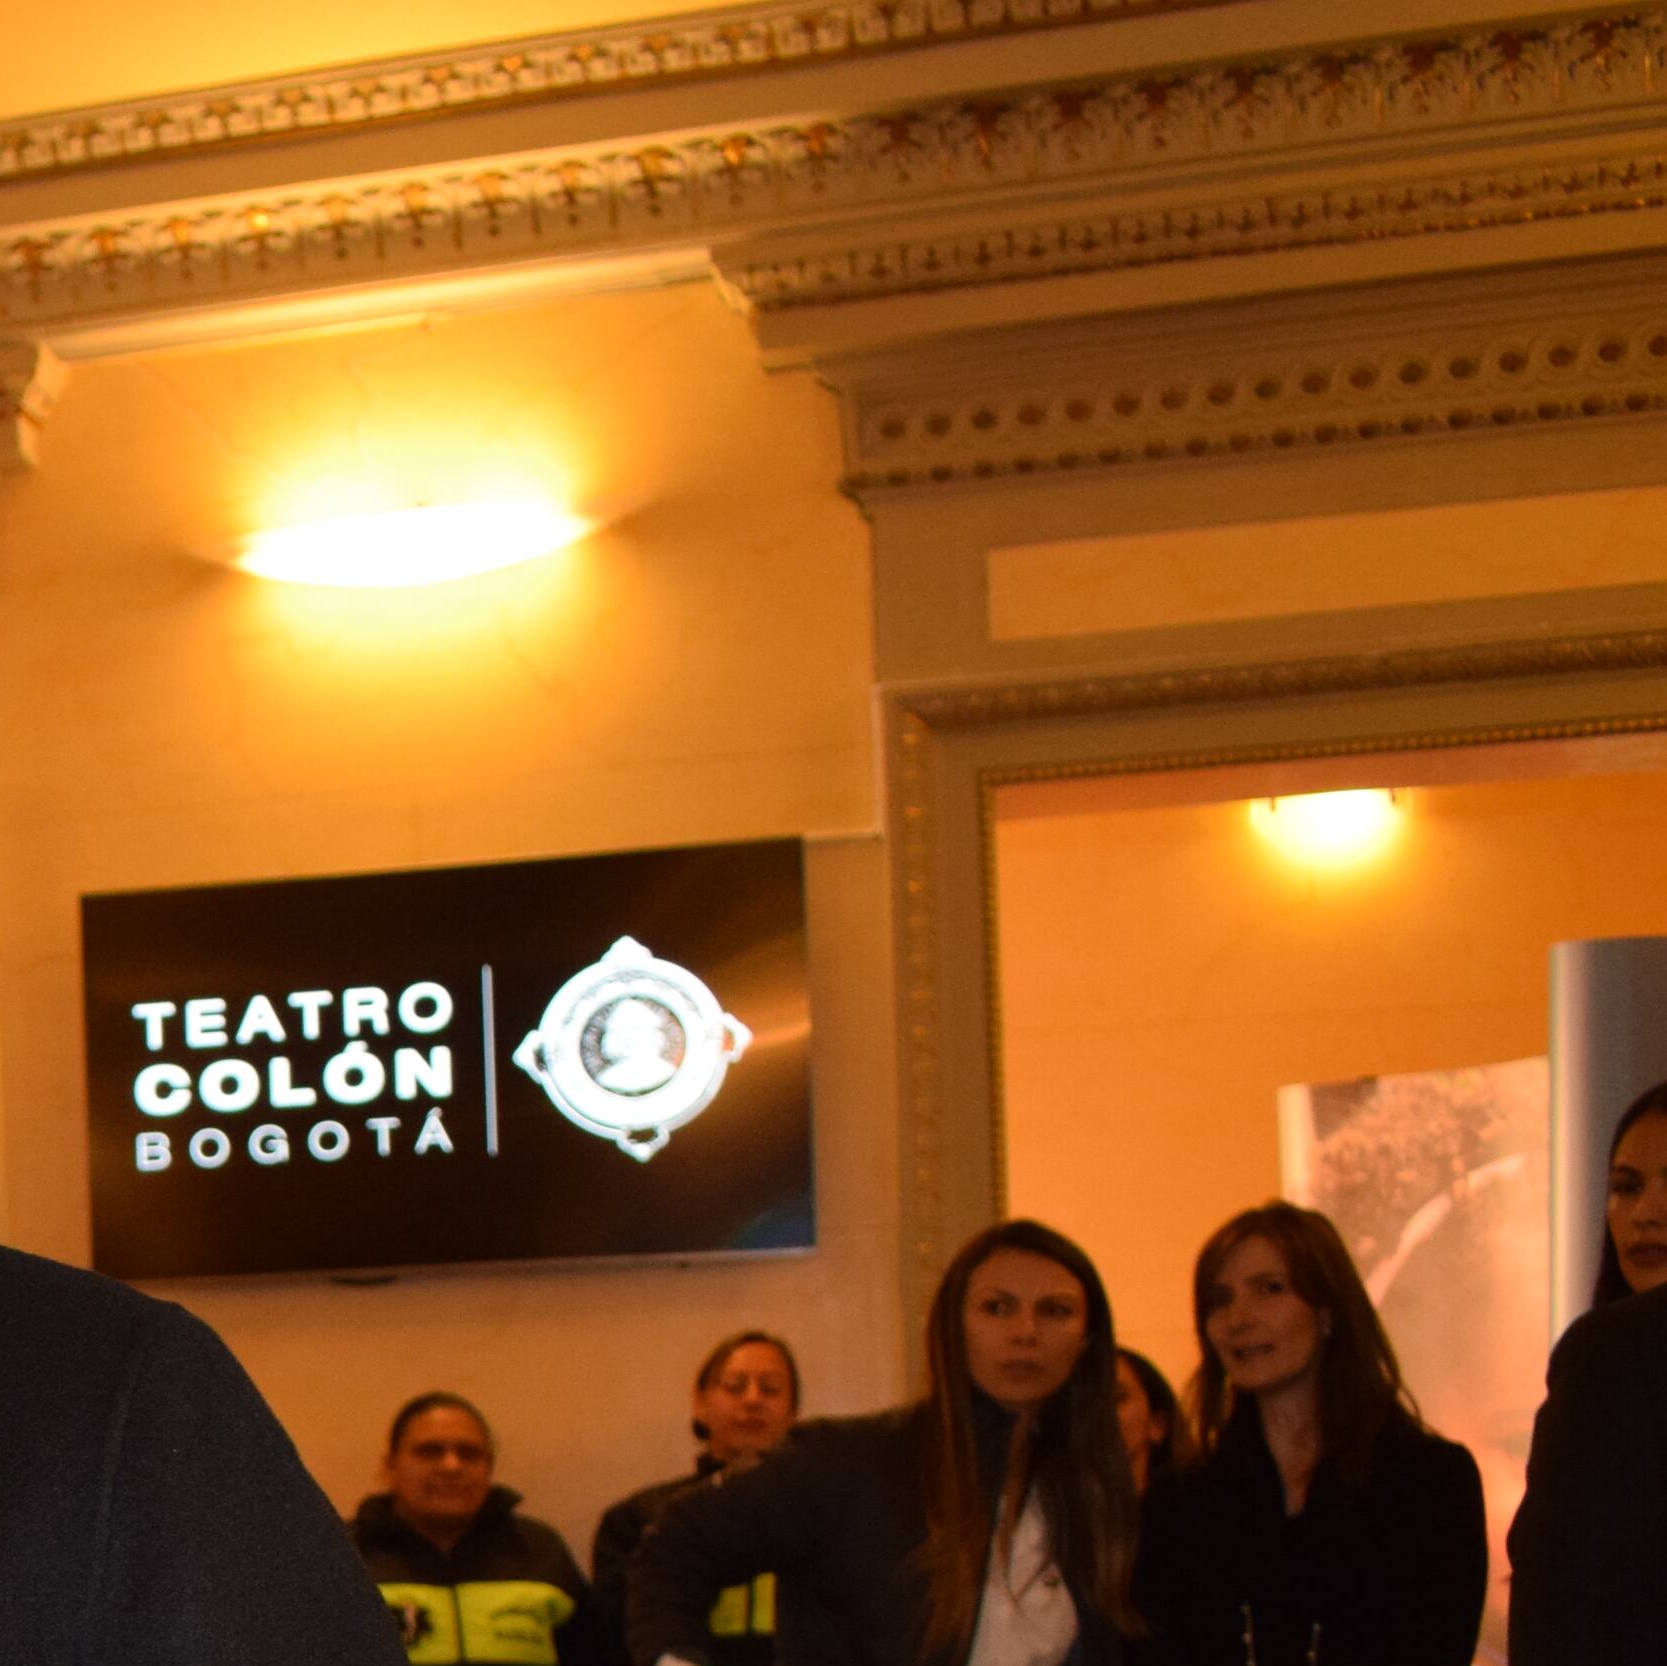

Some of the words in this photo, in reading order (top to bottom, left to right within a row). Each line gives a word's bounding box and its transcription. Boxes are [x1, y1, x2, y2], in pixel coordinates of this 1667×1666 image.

[131, 981, 454, 1051] TEATRO
[133, 1039, 454, 1117] COLÓN
[134, 1106, 455, 1173] BOGOTÁ
